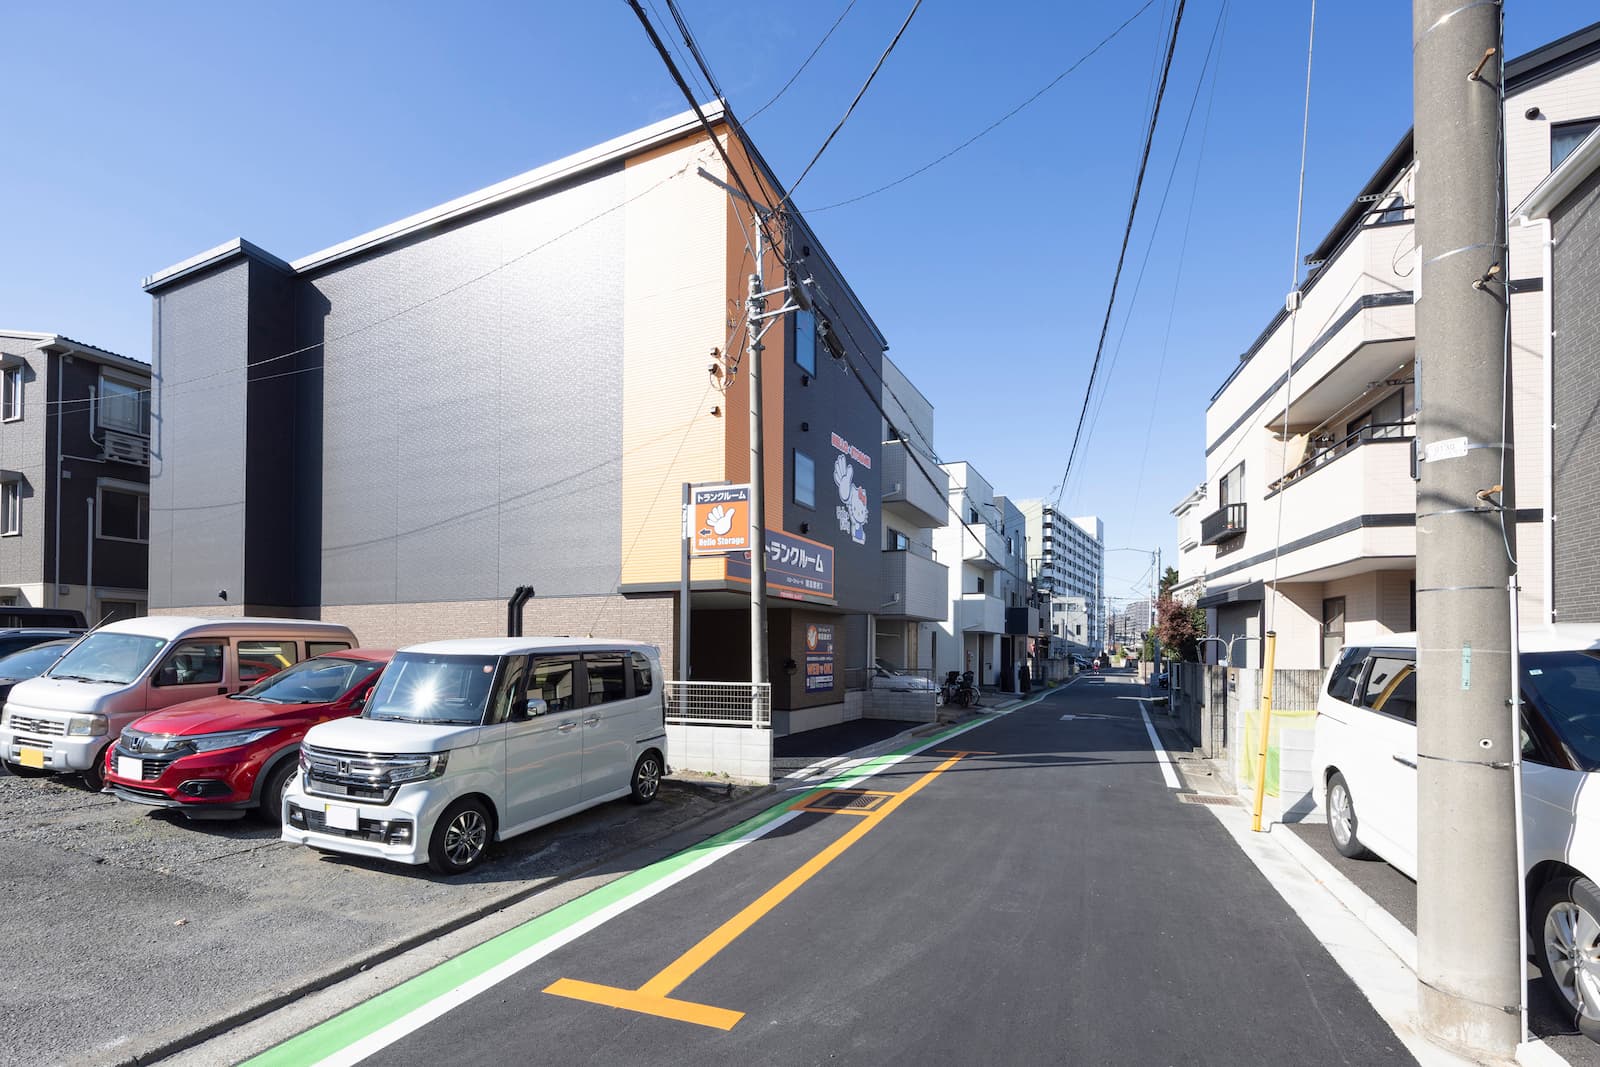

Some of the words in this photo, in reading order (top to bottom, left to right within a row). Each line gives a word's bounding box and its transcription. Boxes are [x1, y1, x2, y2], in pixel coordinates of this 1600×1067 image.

[697, 490, 746, 503] トランクルーム
[717, 537, 745, 546] Storage
